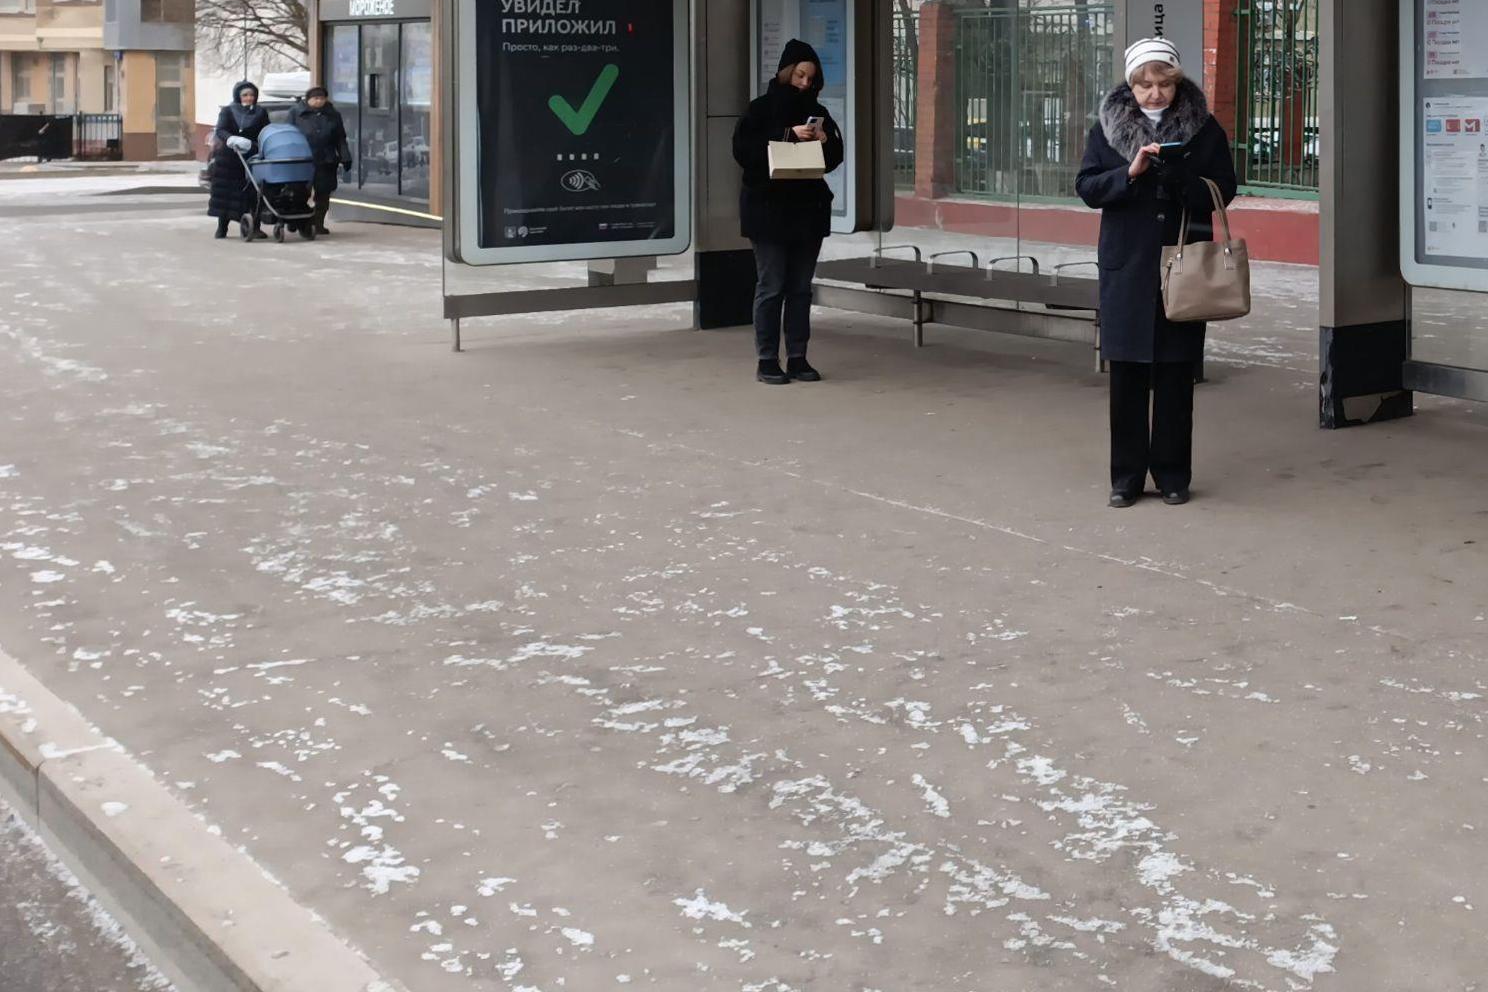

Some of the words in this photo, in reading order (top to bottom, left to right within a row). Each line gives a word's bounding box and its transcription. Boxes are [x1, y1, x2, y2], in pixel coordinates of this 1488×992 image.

[502, 19, 616, 35] ПРИЛОЖИЛ
[1153, 3, 1166, 38] ица
[502, 42, 541, 53] Просто,
[561, 44, 620, 53] раз-два-три.
